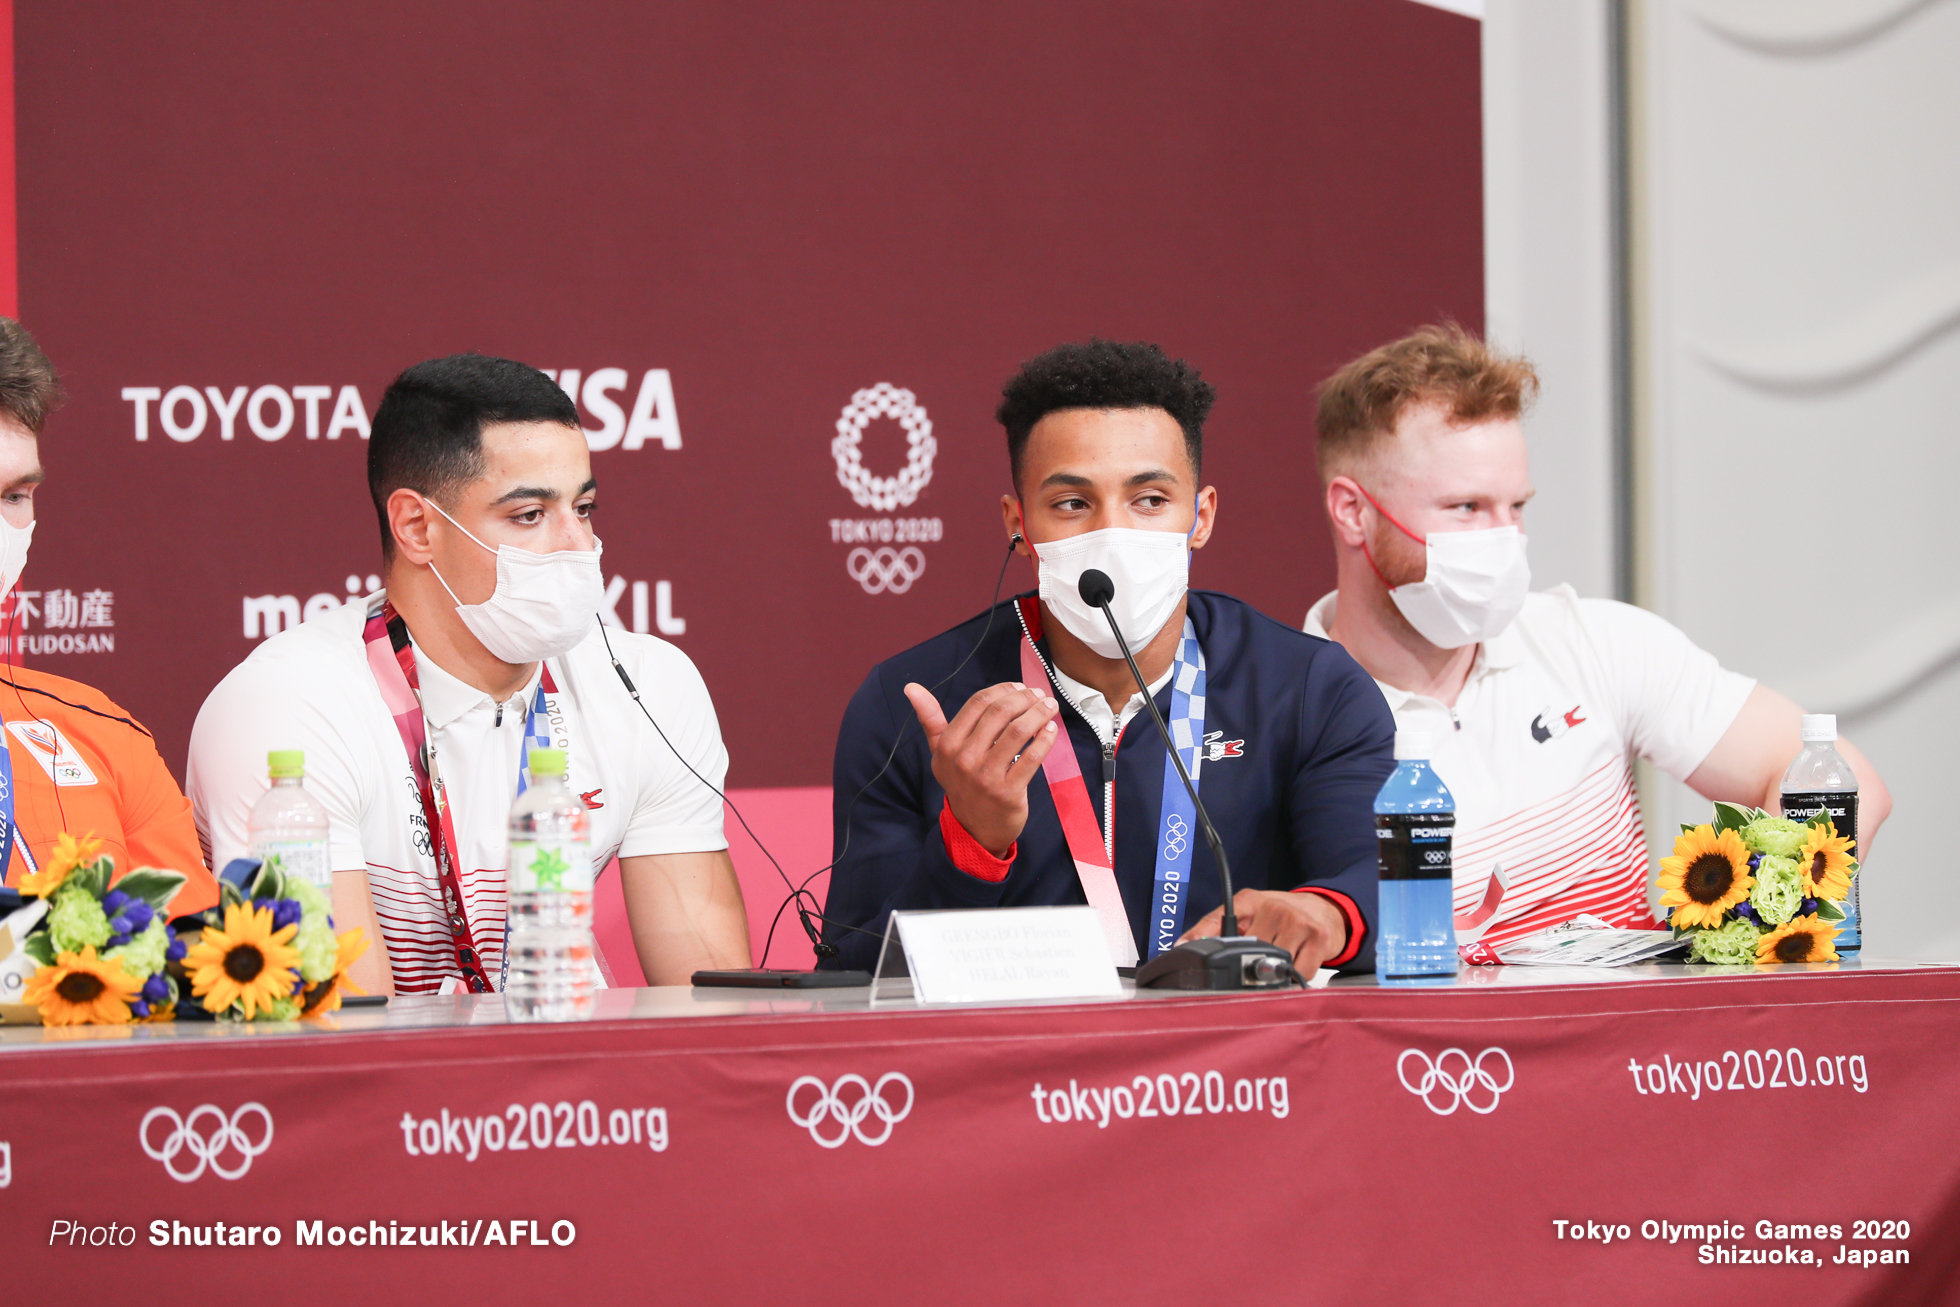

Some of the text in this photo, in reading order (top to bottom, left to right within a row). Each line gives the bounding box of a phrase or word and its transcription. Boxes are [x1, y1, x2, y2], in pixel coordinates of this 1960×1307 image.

[121, 384, 372, 443] TOYOTA
[829, 517, 943, 543] TOKYO 2020
[17, 633, 115, 655] FUDOSAN
[1161, 871, 1181, 915] 2020
[949, 947, 1006, 963] VIGIER
[1025, 965, 1069, 981] Rayan
[1628, 1047, 1868, 1101] tokyo2020.org
[1031, 1069, 1290, 1129] tokyo2020.org
[400, 1100, 669, 1162] tokyo2020.org
